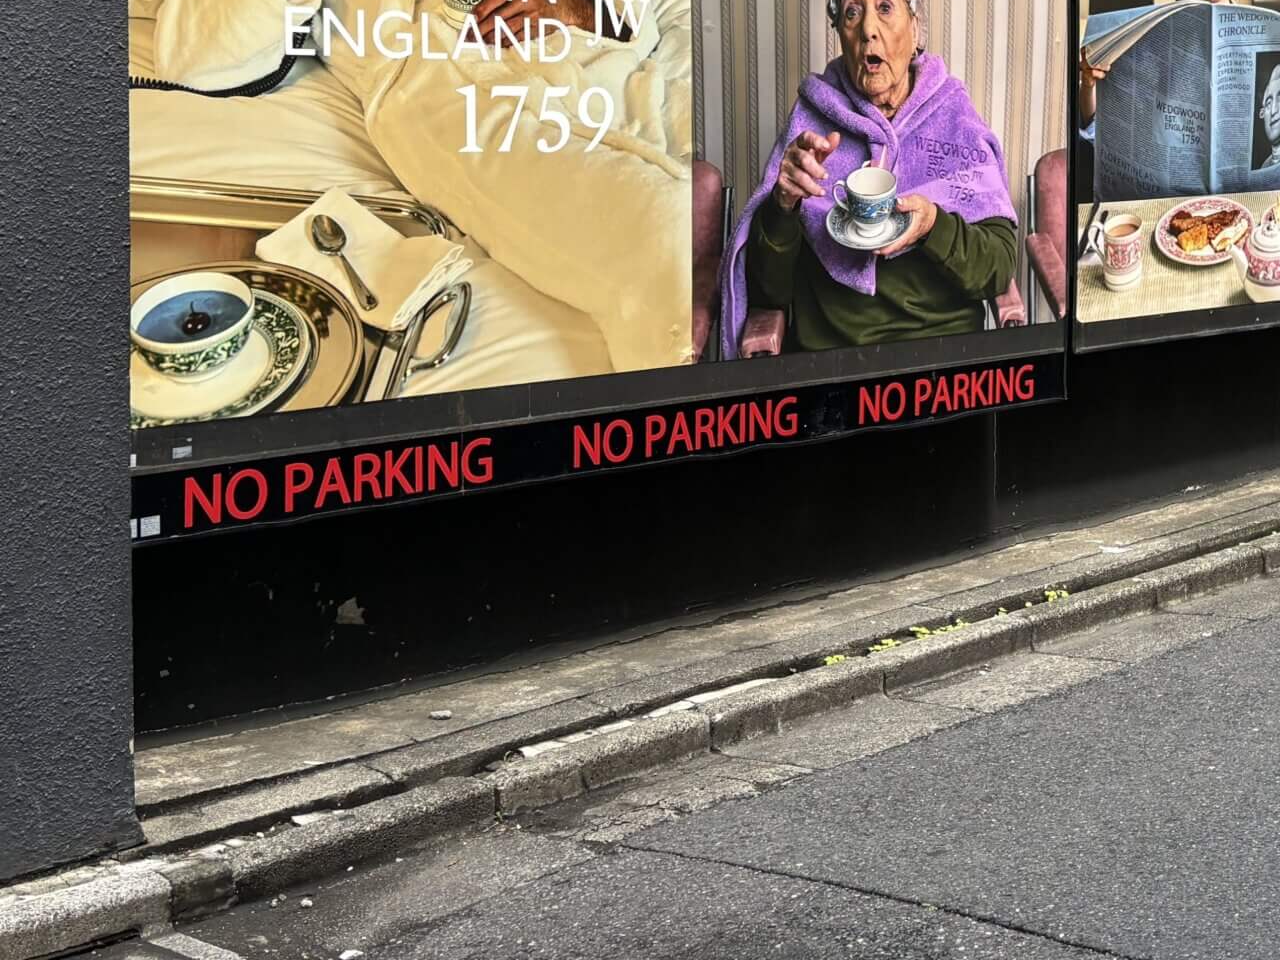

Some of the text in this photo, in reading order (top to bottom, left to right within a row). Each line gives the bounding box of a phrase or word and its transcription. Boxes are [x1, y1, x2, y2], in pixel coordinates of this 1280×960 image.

[284, 10, 572, 63] ENGLAND
[1218, 25, 1265, 38] CHRONICLE
[1219, 12, 1236, 23] THE
[456, 85, 615, 154] 1759
[1182, 134, 1200, 144] 1759
[914, 135, 988, 163] WEDGWOOD
[948, 185, 976, 202] 1759
[858, 364, 1035, 424] NO PARKING
[573, 395, 799, 468] NO PARKING
[184, 437, 494, 529] NO PARKING
